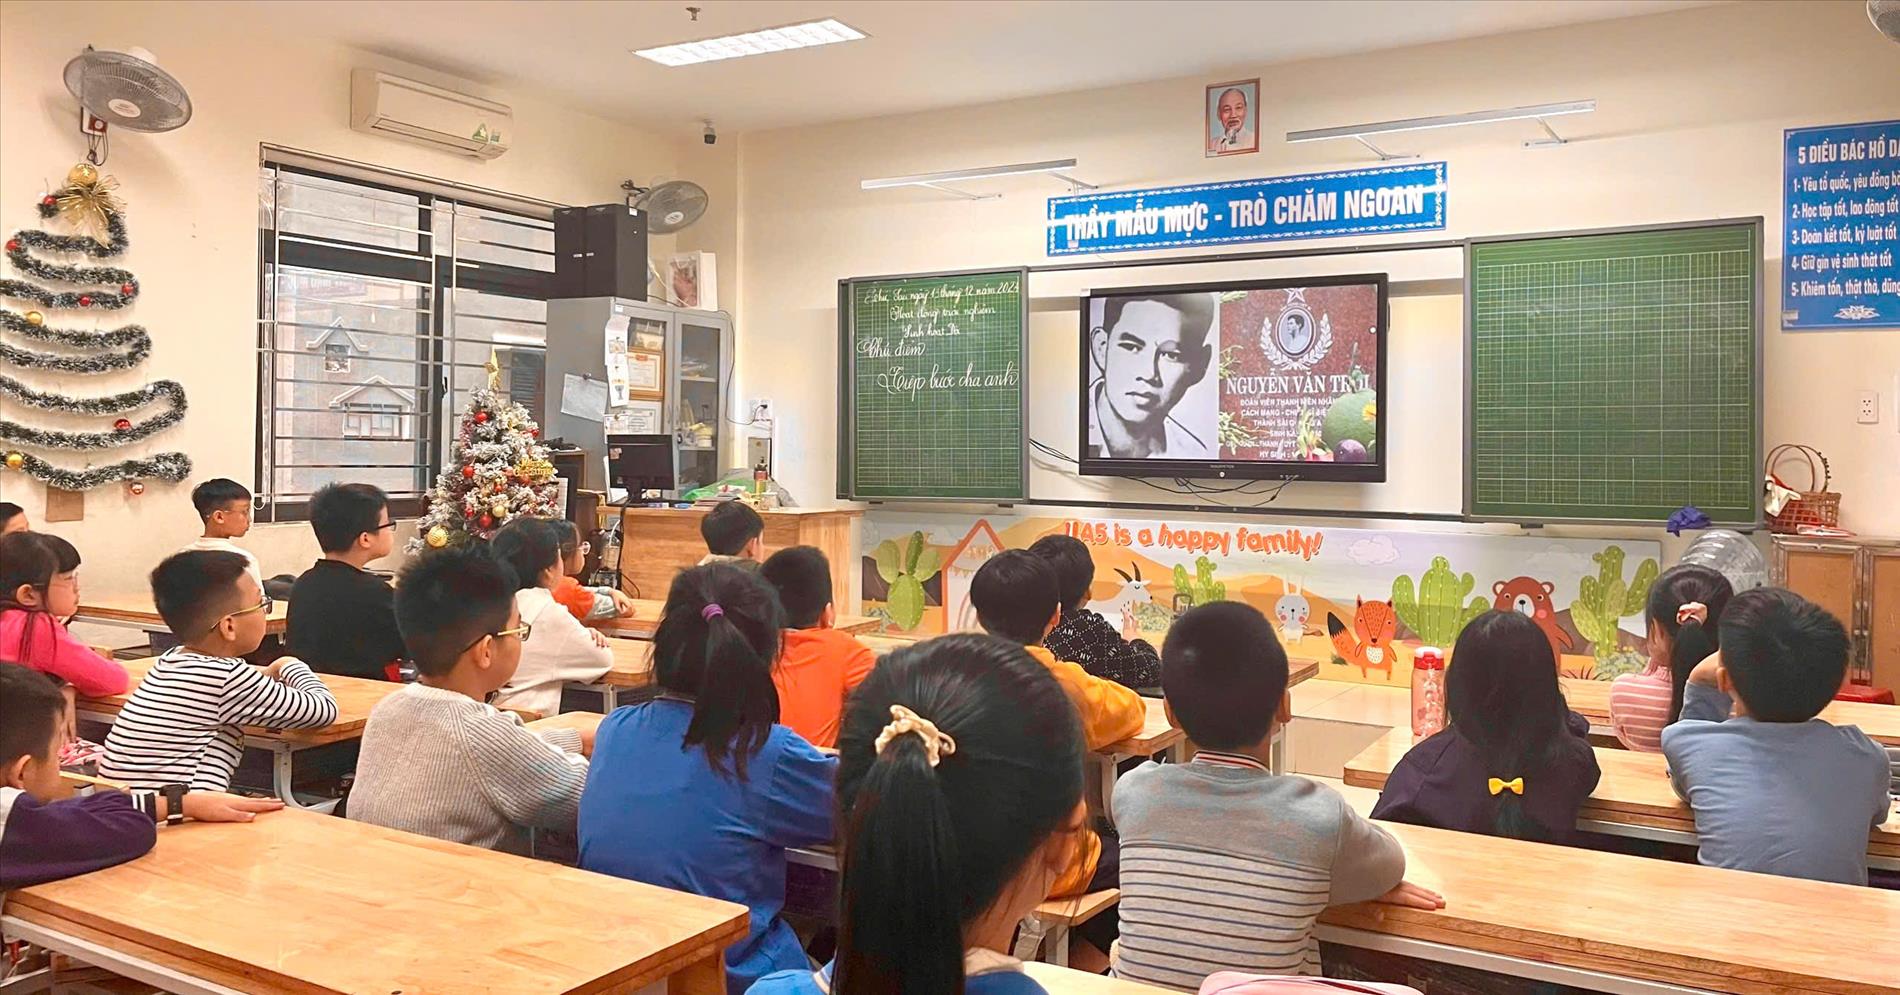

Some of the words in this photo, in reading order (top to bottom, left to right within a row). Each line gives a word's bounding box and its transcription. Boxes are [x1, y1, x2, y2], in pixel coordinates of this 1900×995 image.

[1798, 146, 1806, 164] 5
[1809, 138, 1837, 163] ĐIỀU
[1840, 138, 1865, 161] BÁC
[1868, 133, 1886, 159] HỒ
[1802, 176, 1817, 192] Yêu
[1819, 171, 1828, 191] tổ
[1829, 171, 1852, 194] quốc,
[1853, 173, 1868, 192] yêu
[1869, 169, 1890, 190] đồng
[1064, 203, 1111, 241] THẦY
[1115, 198, 1159, 237] MẪU
[1164, 201, 1209, 237] MỰC
[1228, 191, 1267, 228] TRÒ
[1273, 188, 1337, 225] CHĂM
[1344, 184, 1424, 220] NGOAN
[1802, 202, 1817, 222] Học
[1819, 201, 1832, 221] tập
[1834, 197, 1848, 217] tốt,
[1850, 200, 1863, 215] lao
[1864, 197, 1885, 219] động
[1887, 194, 1899, 213] tốt
[1801, 228, 1822, 245] Đoàn
[1824, 224, 1838, 243] kết
[1839, 223, 1853, 244] tốt,
[1855, 223, 1865, 245] kỷ
[1866, 225, 1883, 245] luật
[1885, 221, 1897, 240] tốt
[1801, 254, 1815, 270] Giữ
[1817, 254, 1829, 273] gìn
[1831, 253, 1840, 274] vệ
[1842, 252, 1859, 269] sinh
[1861, 251, 1878, 272] thật
[1880, 247, 1892, 267] tốt
[910, 288, 930, 304] ngày
[965, 285, 974, 296] 12
[976, 283, 995, 295] năm
[1801, 280, 1826, 297] Khiêm
[1827, 277, 1843, 297] tốn,
[1845, 279, 1862, 300] thật
[1864, 278, 1880, 296] thà,
[930, 363, 956, 389] bước
[959, 361, 982, 387] cha
[985, 360, 1019, 387] anh
[1226, 368, 1288, 394] NGUYỄN
[1291, 372, 1326, 394] VĂN
[1241, 407, 1259, 416] CÁCH
[1114, 523, 1131, 546] is
[1138, 528, 1153, 547] a
[1158, 523, 1231, 557] happy
[1236, 527, 1323, 561] family!
